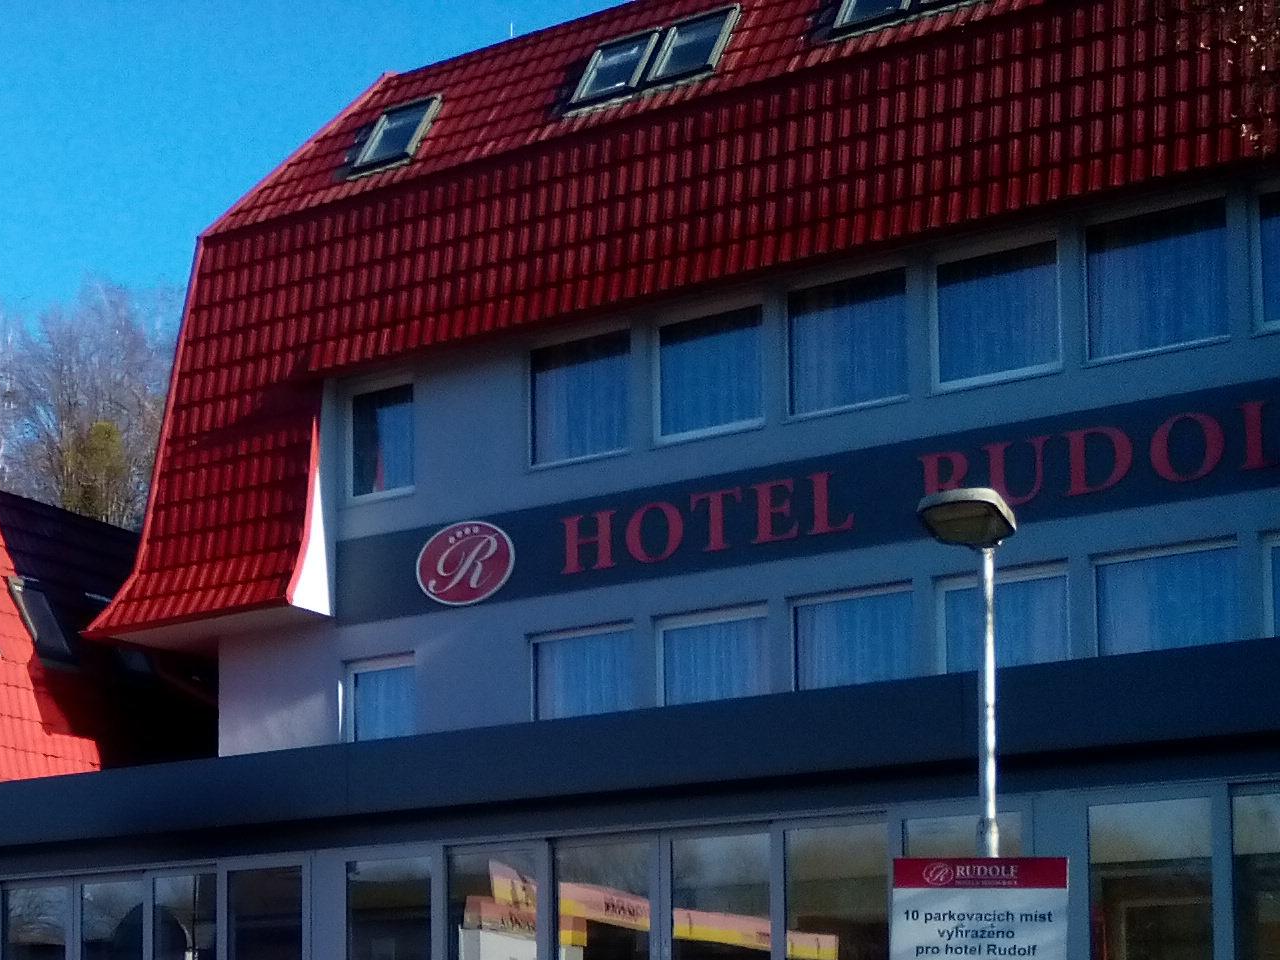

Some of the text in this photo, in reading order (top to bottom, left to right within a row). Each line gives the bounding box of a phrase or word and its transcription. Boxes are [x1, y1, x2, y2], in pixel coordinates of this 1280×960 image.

[561, 471, 855, 574] HOTEL
[956, 865, 1018, 877] RUDOLF
[904, 909, 919, 921] 10
[915, 944, 1037, 957] pro hotel Rudolf
